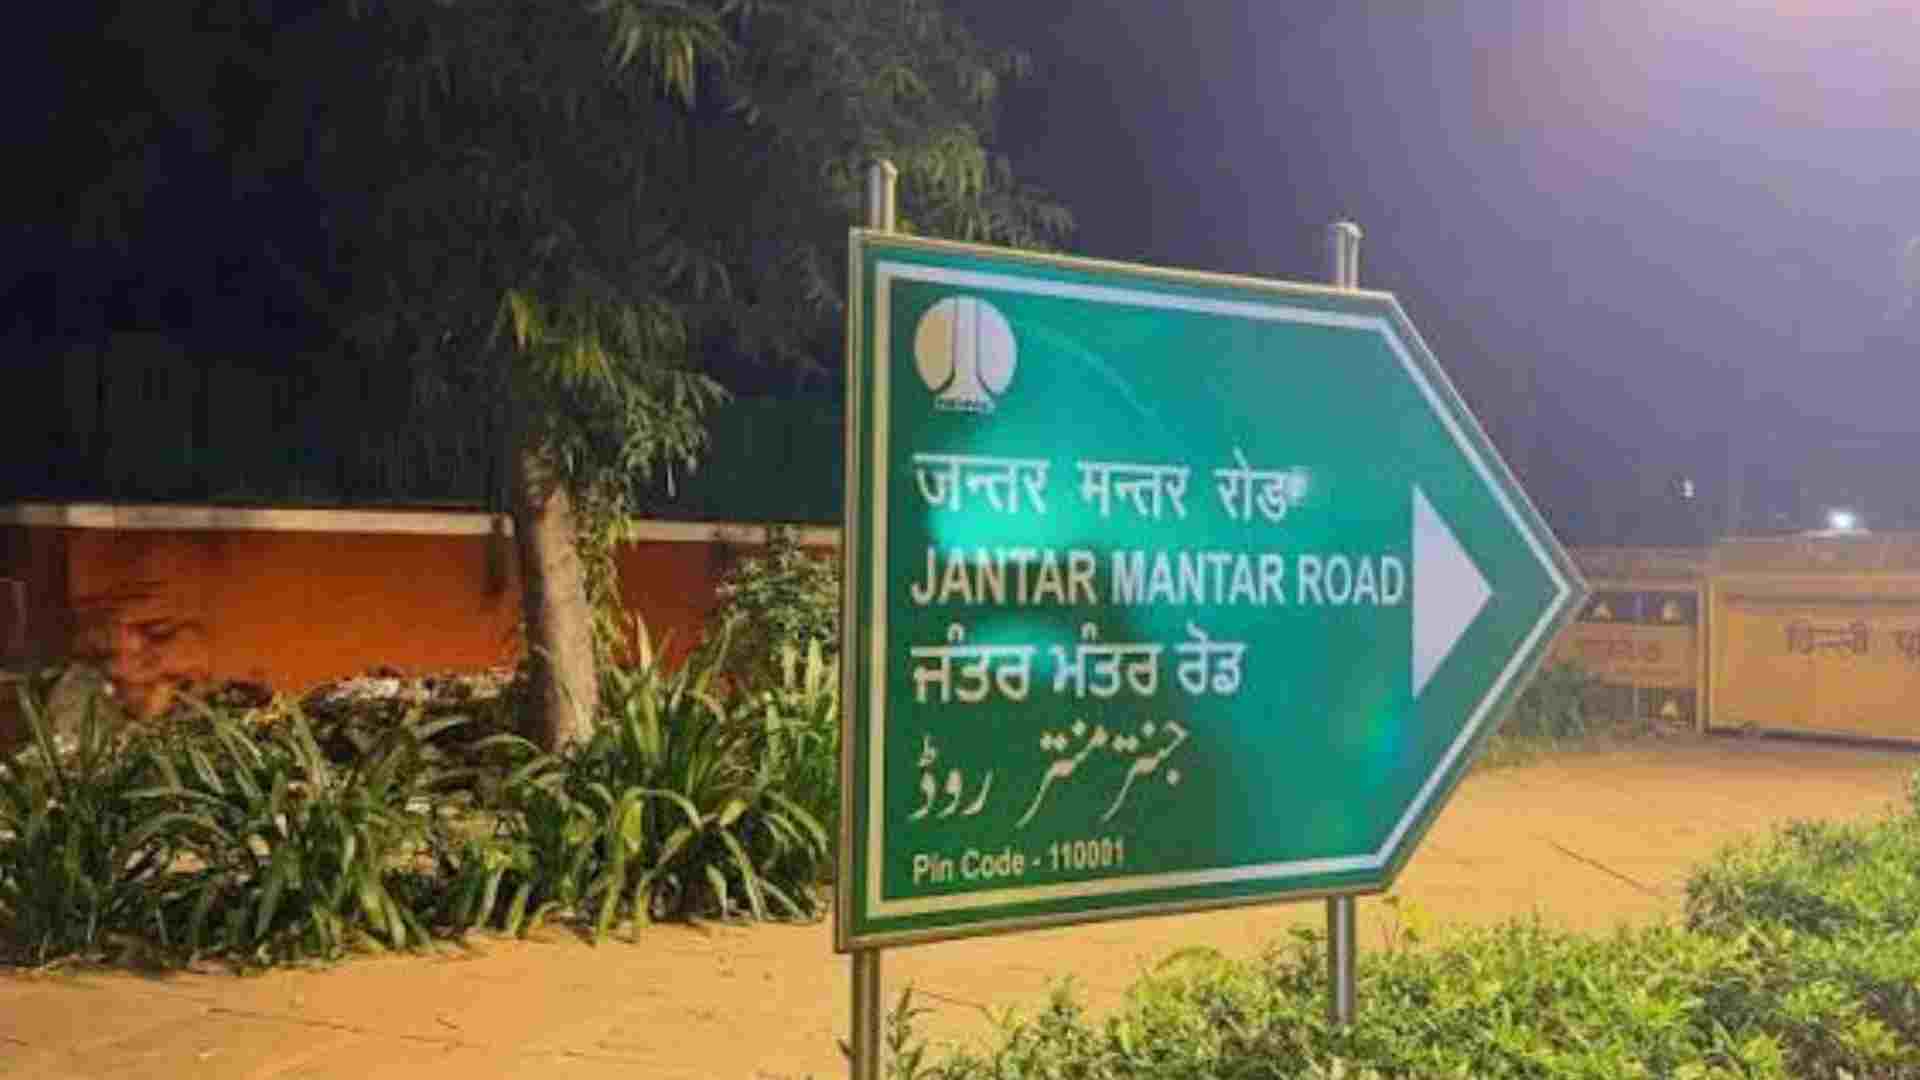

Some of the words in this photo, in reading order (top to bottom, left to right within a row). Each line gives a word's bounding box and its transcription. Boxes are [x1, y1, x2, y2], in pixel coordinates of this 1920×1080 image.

[913, 453, 1049, 515] जन्तर
[1077, 459, 1191, 518] मन्तर
[1213, 447, 1291, 521] रोड
[912, 548, 1098, 606] JANTAR
[1111, 551, 1285, 608] MANTAR
[1297, 555, 1404, 608] ROAD
[911, 623, 1036, 703] ਜੰਤਰ
[1049, 622, 1164, 697] ਮੰਤਰ
[1174, 624, 1248, 695] ਰੋਡ
[908, 735, 993, 822] روڈ
[913, 853, 954, 884] Pin
[960, 847, 1026, 880] Code
[1049, 837, 1125, 872] 110001
